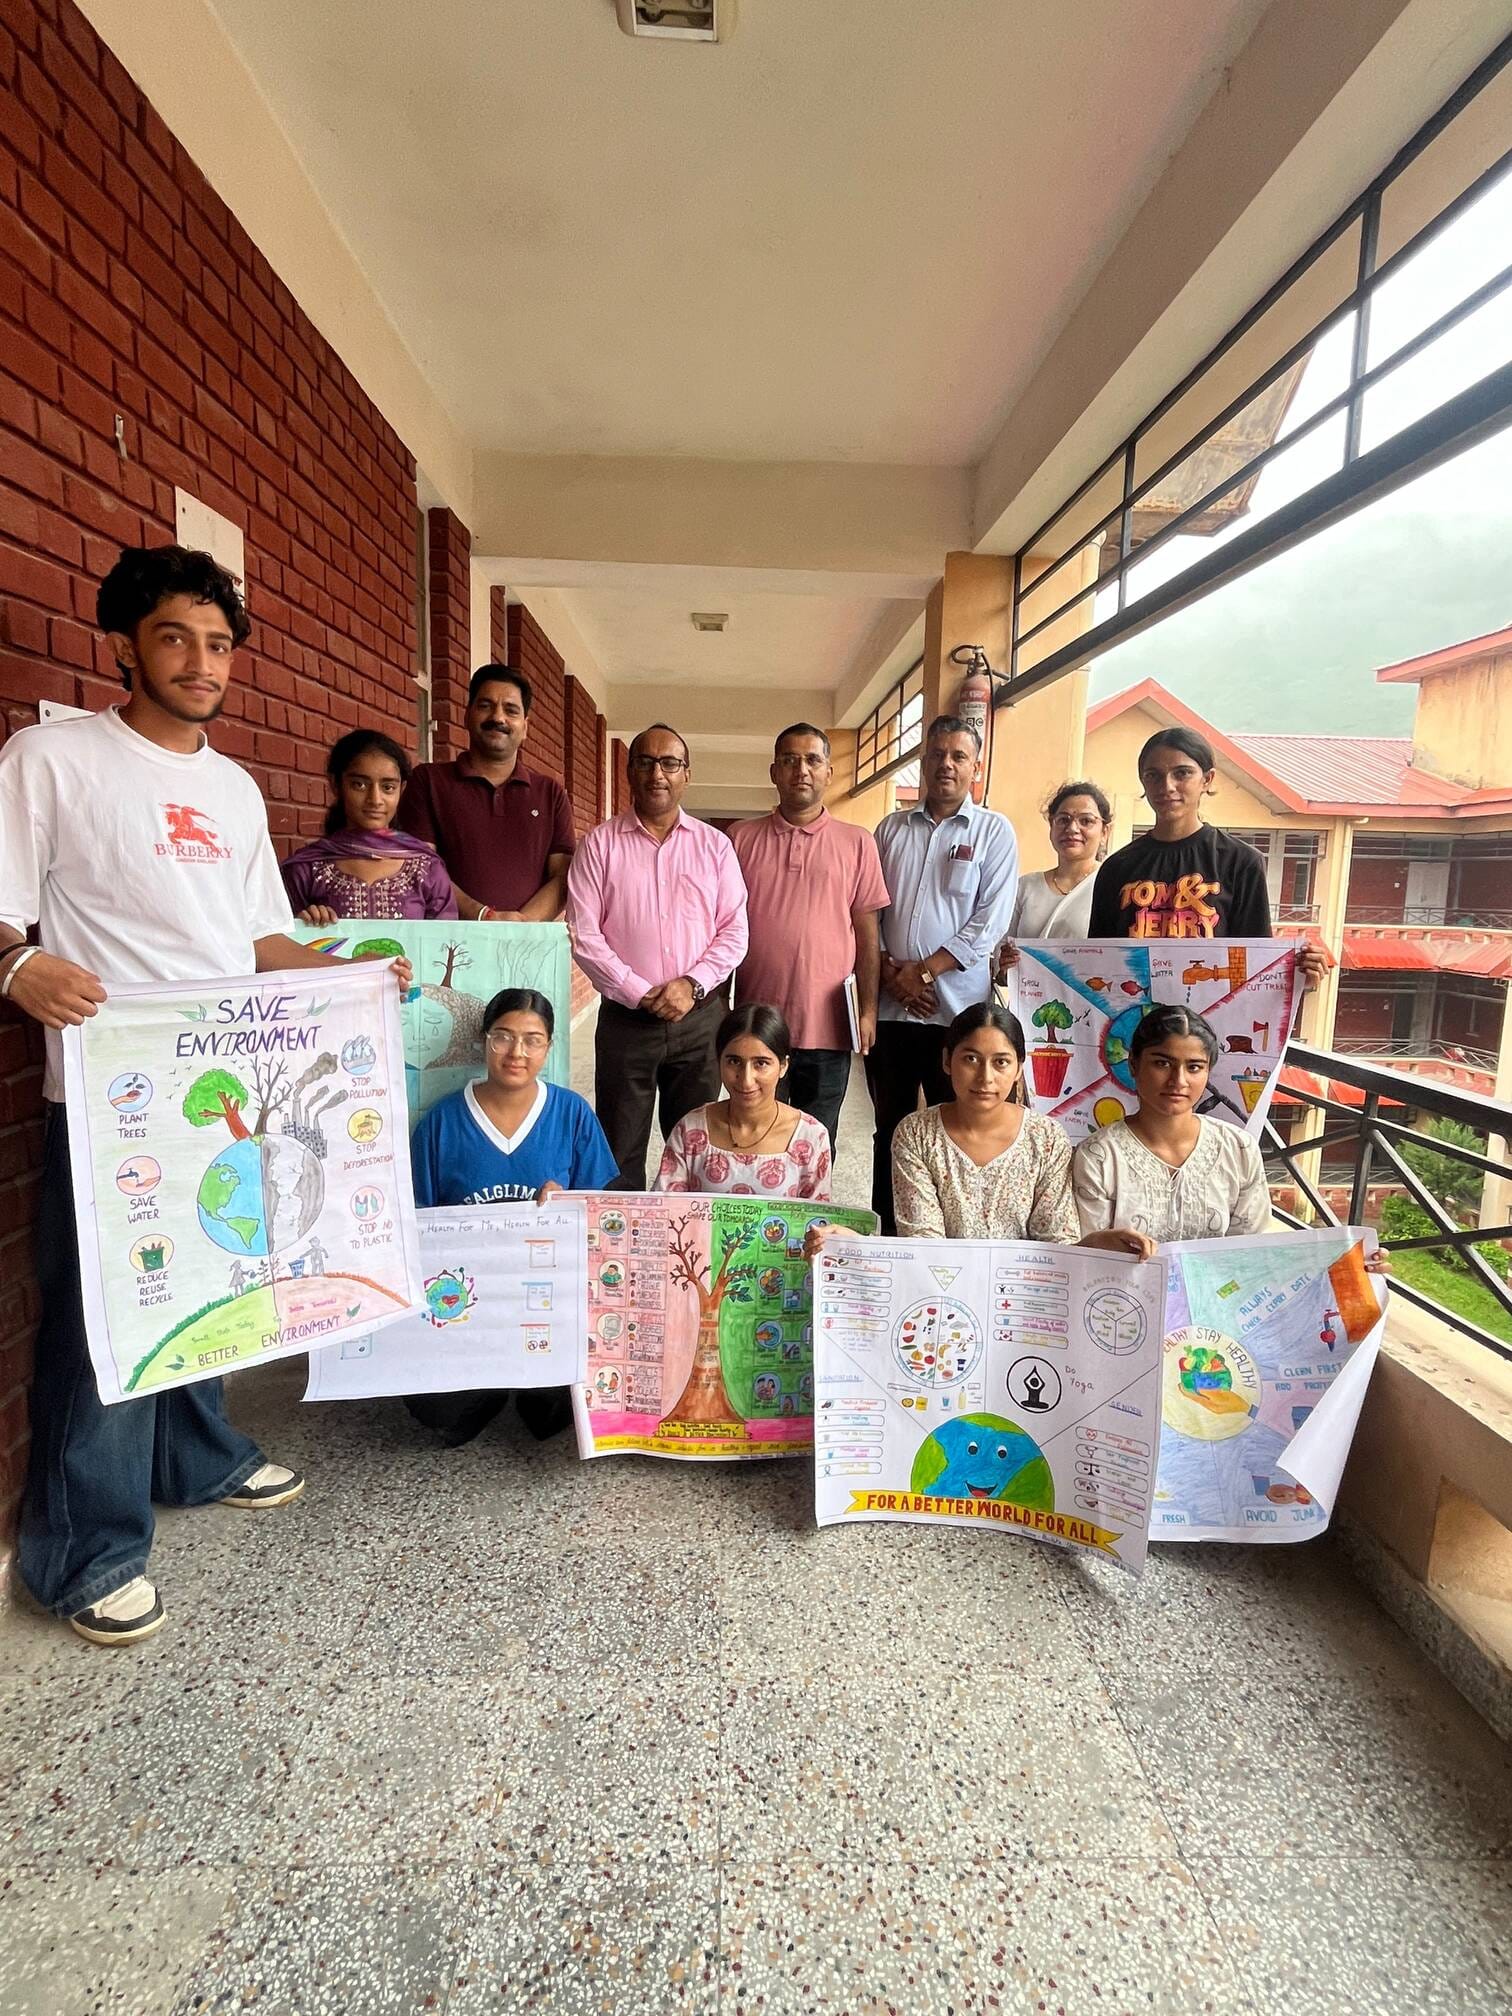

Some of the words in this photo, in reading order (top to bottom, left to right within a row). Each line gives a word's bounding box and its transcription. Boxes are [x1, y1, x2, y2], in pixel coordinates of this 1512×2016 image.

[153, 843, 234, 859] BURBERRY
[1119, 879, 1177, 911] TOM
[1173, 872, 1221, 917] &
[1128, 907, 1220, 938] JERRY
[1246, 983, 1261, 992] CUT
[216, 996, 296, 1024] SAVE
[176, 1025, 322, 1058] ENVIRONMENT
[351, 1076, 371, 1087] STOP
[349, 1088, 388, 1100] POLLUTION
[119, 1113, 149, 1125] PLANT
[117, 1128, 147, 1139] TREES
[356, 1142, 377, 1155] STOP
[343, 1153, 395, 1171] DEFORESTATION
[130, 1195, 157, 1210] SAVE
[690, 1200, 710, 1213] OUR
[711, 1201, 741, 1215] CHOICES
[128, 1208, 160, 1224] WATER
[358, 1222, 378, 1235] STOP
[382, 1221, 393, 1231] NO
[363, 1233, 393, 1249] PLASTIC
[838, 1247, 863, 1257] FOOD
[870, 1250, 915, 1260] NUTRITION
[1018, 1255, 1054, 1265] HEALTH
[136, 1270, 169, 1285] REDUCE
[139, 1283, 167, 1296] REUSE
[139, 1292, 174, 1307] RECYCLE
[197, 1345, 239, 1367] BETTER
[261, 1315, 342, 1348] ENVIRONMENT
[1196, 1327, 1222, 1344] STAY
[1225, 1341, 1257, 1390] HEALTHY
[1283, 1367, 1312, 1378] CLEAN
[1070, 1377, 1095, 1394] Yoga
[866, 1494, 896, 1510] FOR
[900, 1495, 910, 1511] A
[914, 1497, 974, 1516] BETTER
[977, 1500, 1031, 1526] WORLD
[1034, 1512, 1065, 1535] FOR
[1069, 1522, 1099, 1545] ALL
[1162, 1513, 1186, 1525] FRESH
[1246, 1510, 1278, 1522] AVOID
